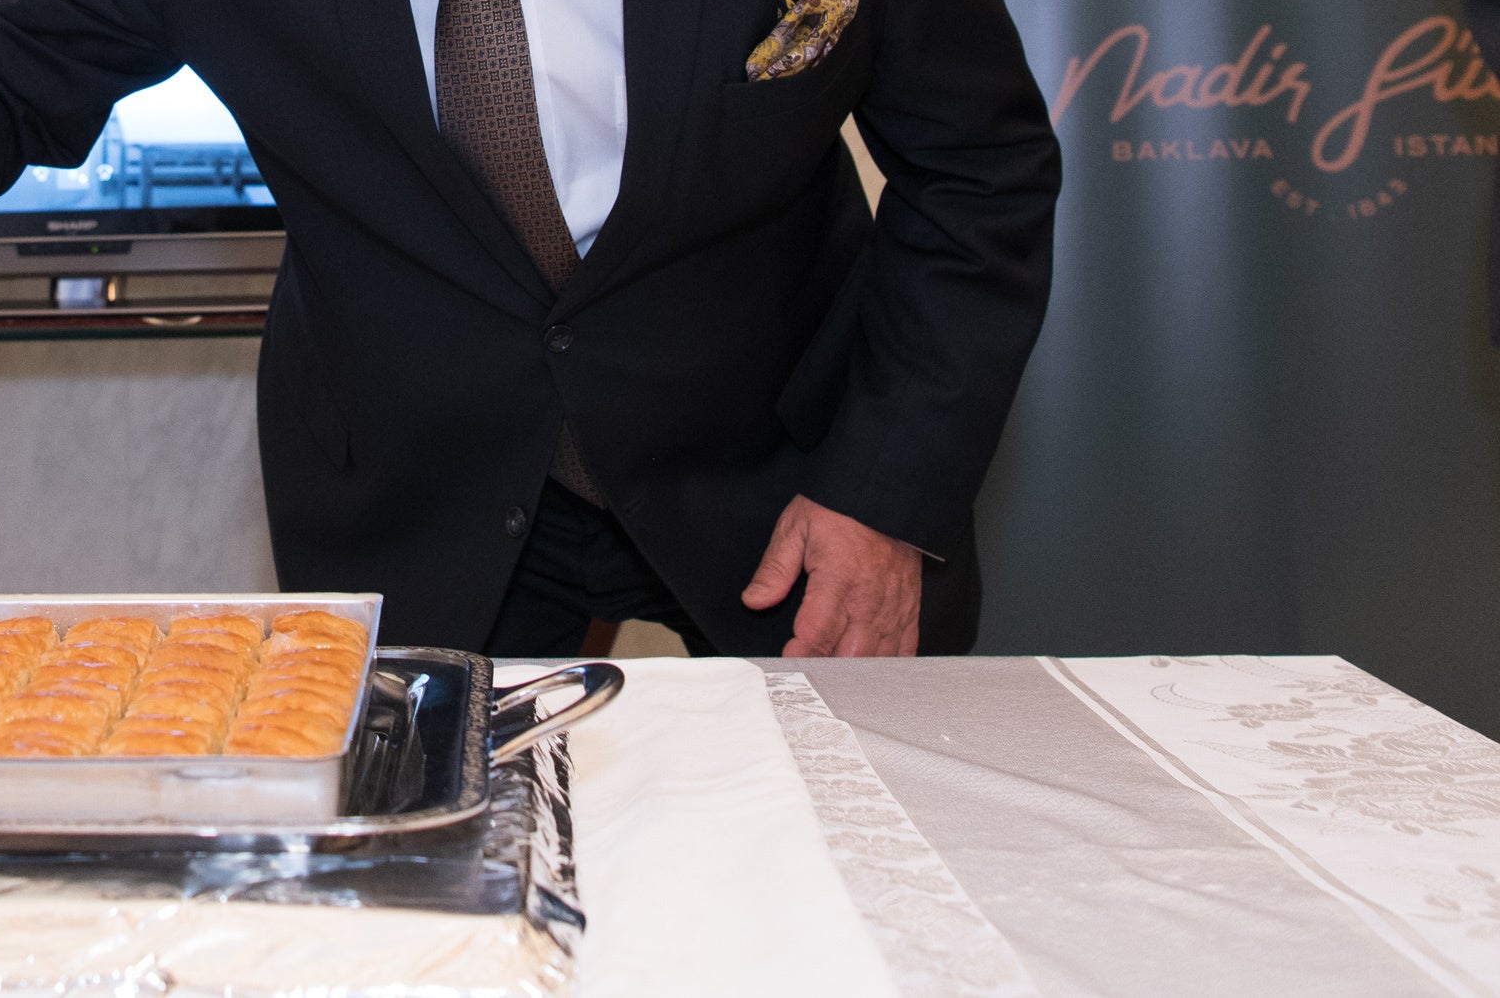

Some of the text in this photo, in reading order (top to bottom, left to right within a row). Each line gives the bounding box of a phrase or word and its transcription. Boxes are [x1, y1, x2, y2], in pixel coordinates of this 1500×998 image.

[1050, 23, 1311, 124] Nadir
[1111, 133, 1499, 163] BAKLAVA ISTAN
